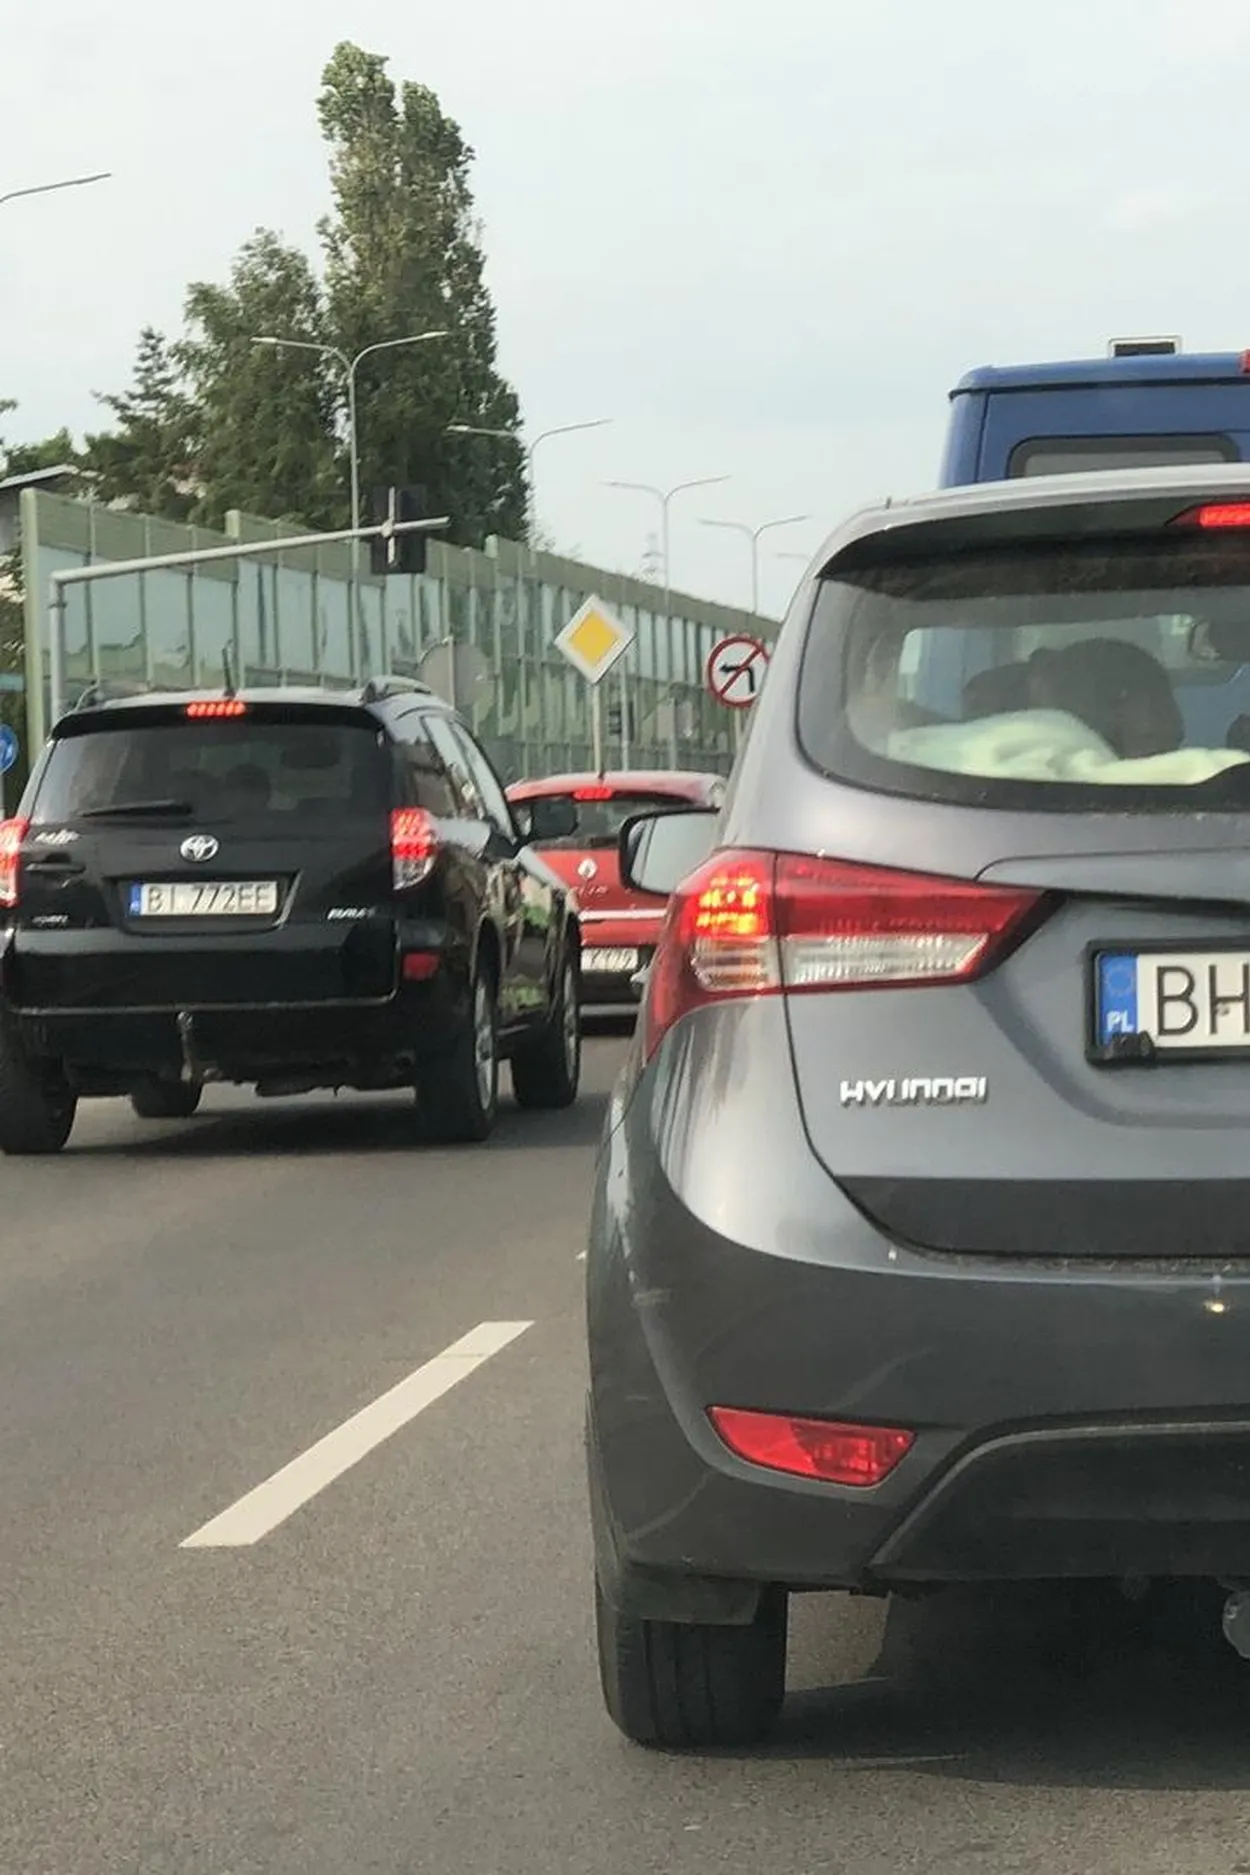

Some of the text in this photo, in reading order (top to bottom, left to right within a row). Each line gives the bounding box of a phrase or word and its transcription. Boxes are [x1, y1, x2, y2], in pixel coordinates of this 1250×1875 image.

[147, 886, 176, 913] BI
[1107, 1010, 1134, 1032] PL
[840, 1077, 987, 1103] HYUNDAI
